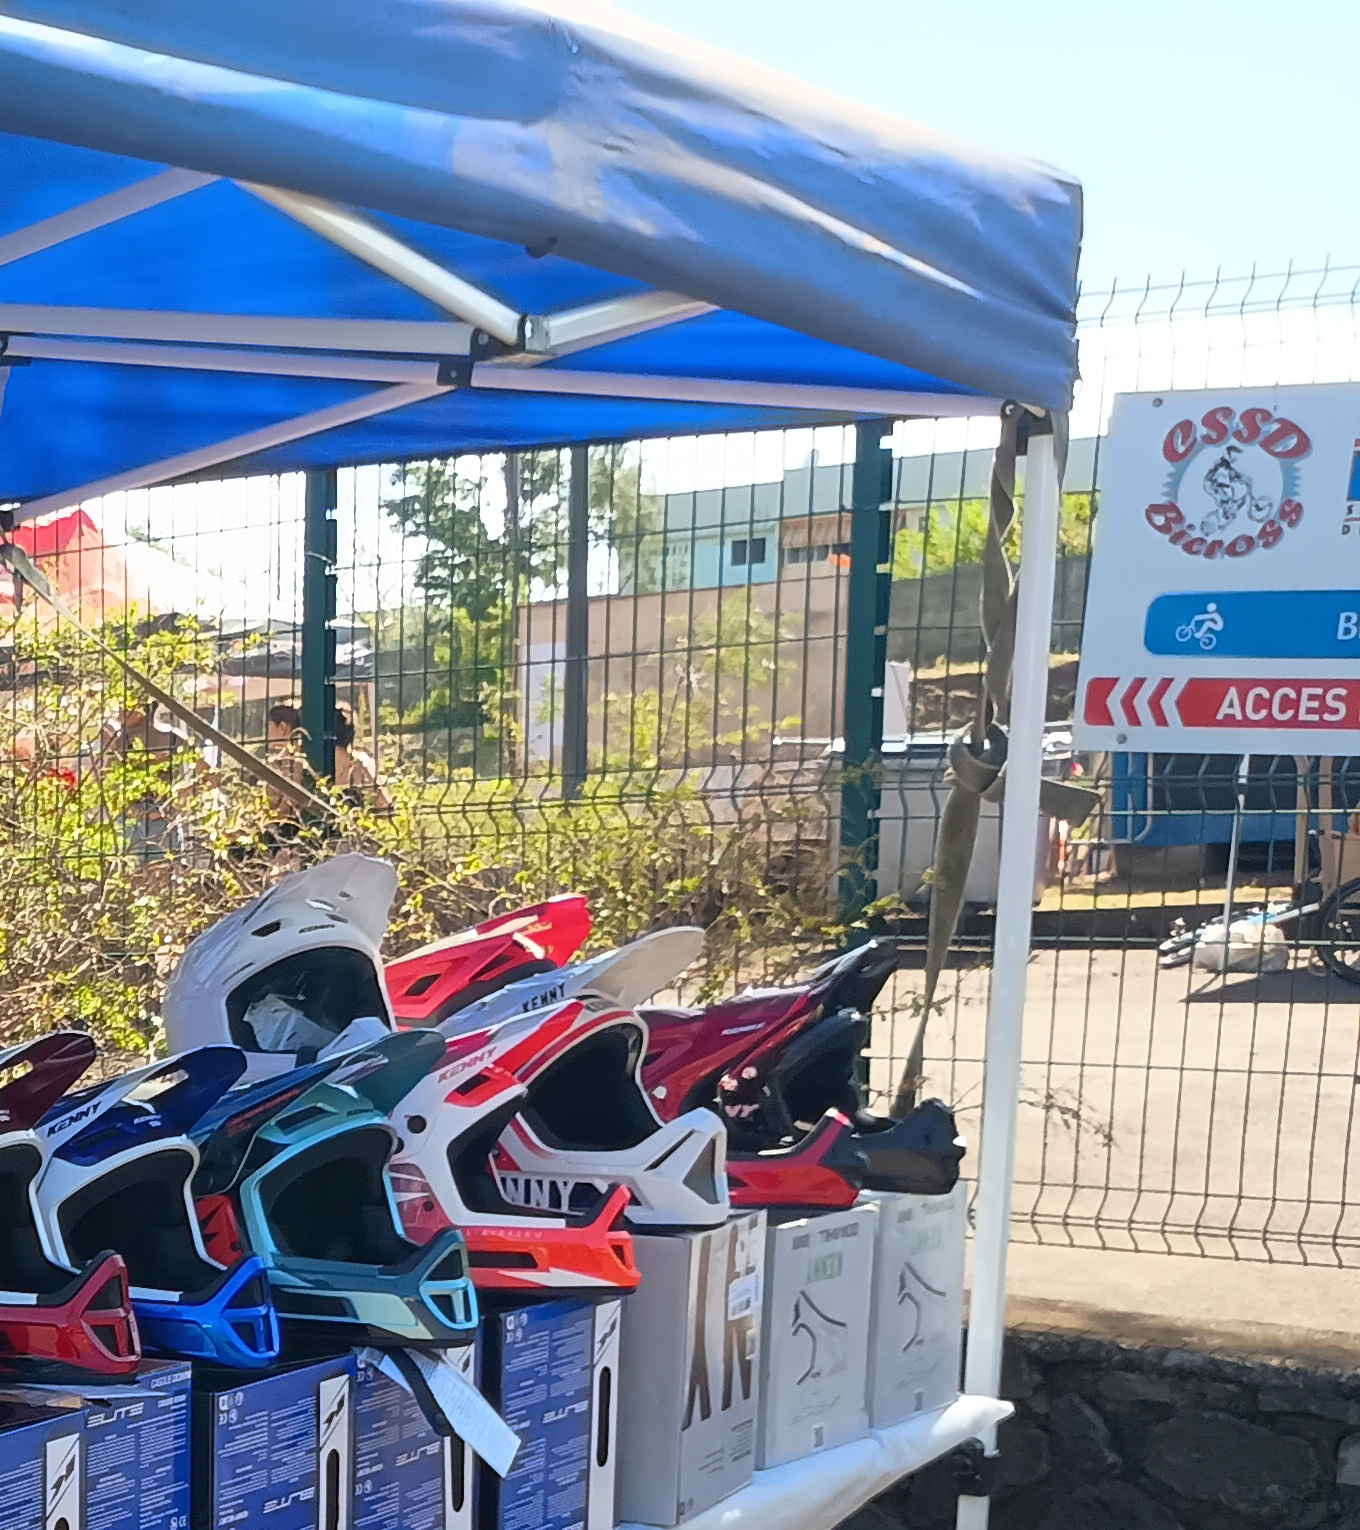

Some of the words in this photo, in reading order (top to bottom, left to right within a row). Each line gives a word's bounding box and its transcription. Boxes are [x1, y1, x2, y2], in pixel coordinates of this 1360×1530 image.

[1162, 406, 1310, 463] CSSD
[1145, 497, 1303, 559] Bicross
[1337, 611, 1360, 640] B
[1216, 685, 1348, 722] ACCES
[521, 982, 567, 1014] KENNY
[437, 1045, 499, 1086] KENNY
[47, 1100, 103, 1138] KENNY
